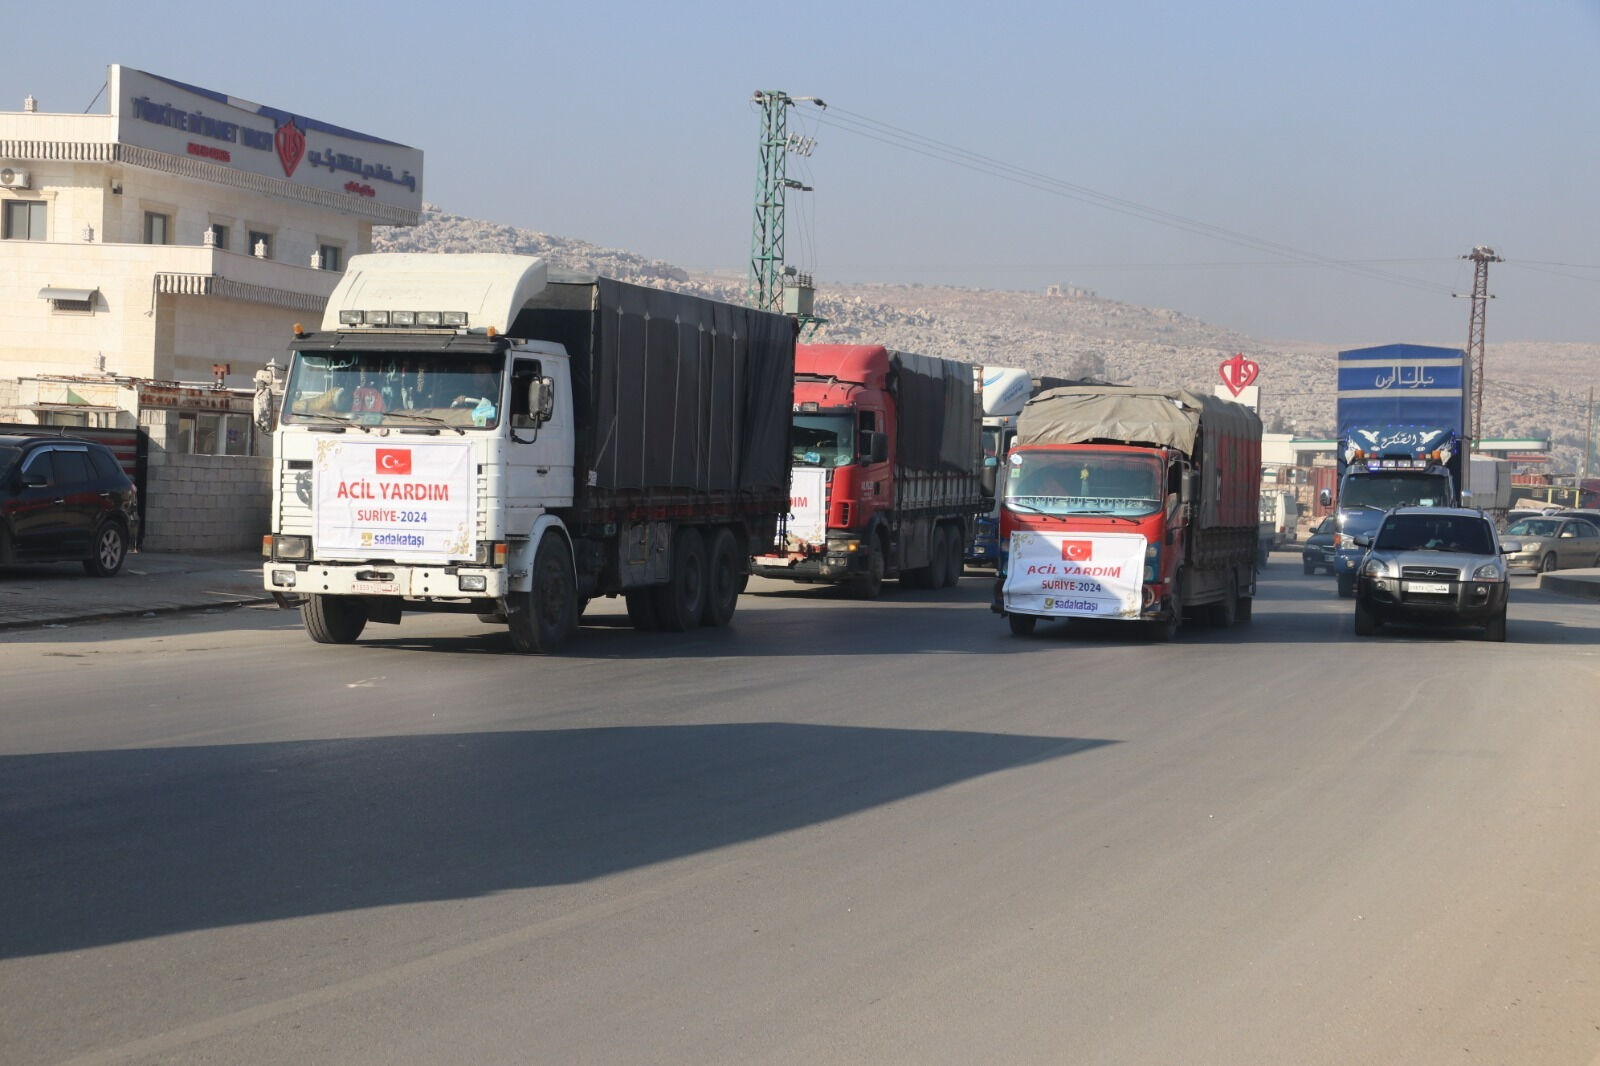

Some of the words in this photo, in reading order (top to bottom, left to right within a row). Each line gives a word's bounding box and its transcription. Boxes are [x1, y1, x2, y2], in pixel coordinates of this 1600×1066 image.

[337, 478, 375, 499] ACİL
[379, 482, 449, 501] YARDIM
[357, 508, 428, 523] SURİYE-2024
[374, 533, 425, 548] sadakataşı
[1027, 563, 1057, 576] ACİL
[1063, 566, 1121, 578] YARDIM
[1042, 579, 1102, 592] SURİYE-2024
[1055, 599, 1099, 612] sadakataşı
